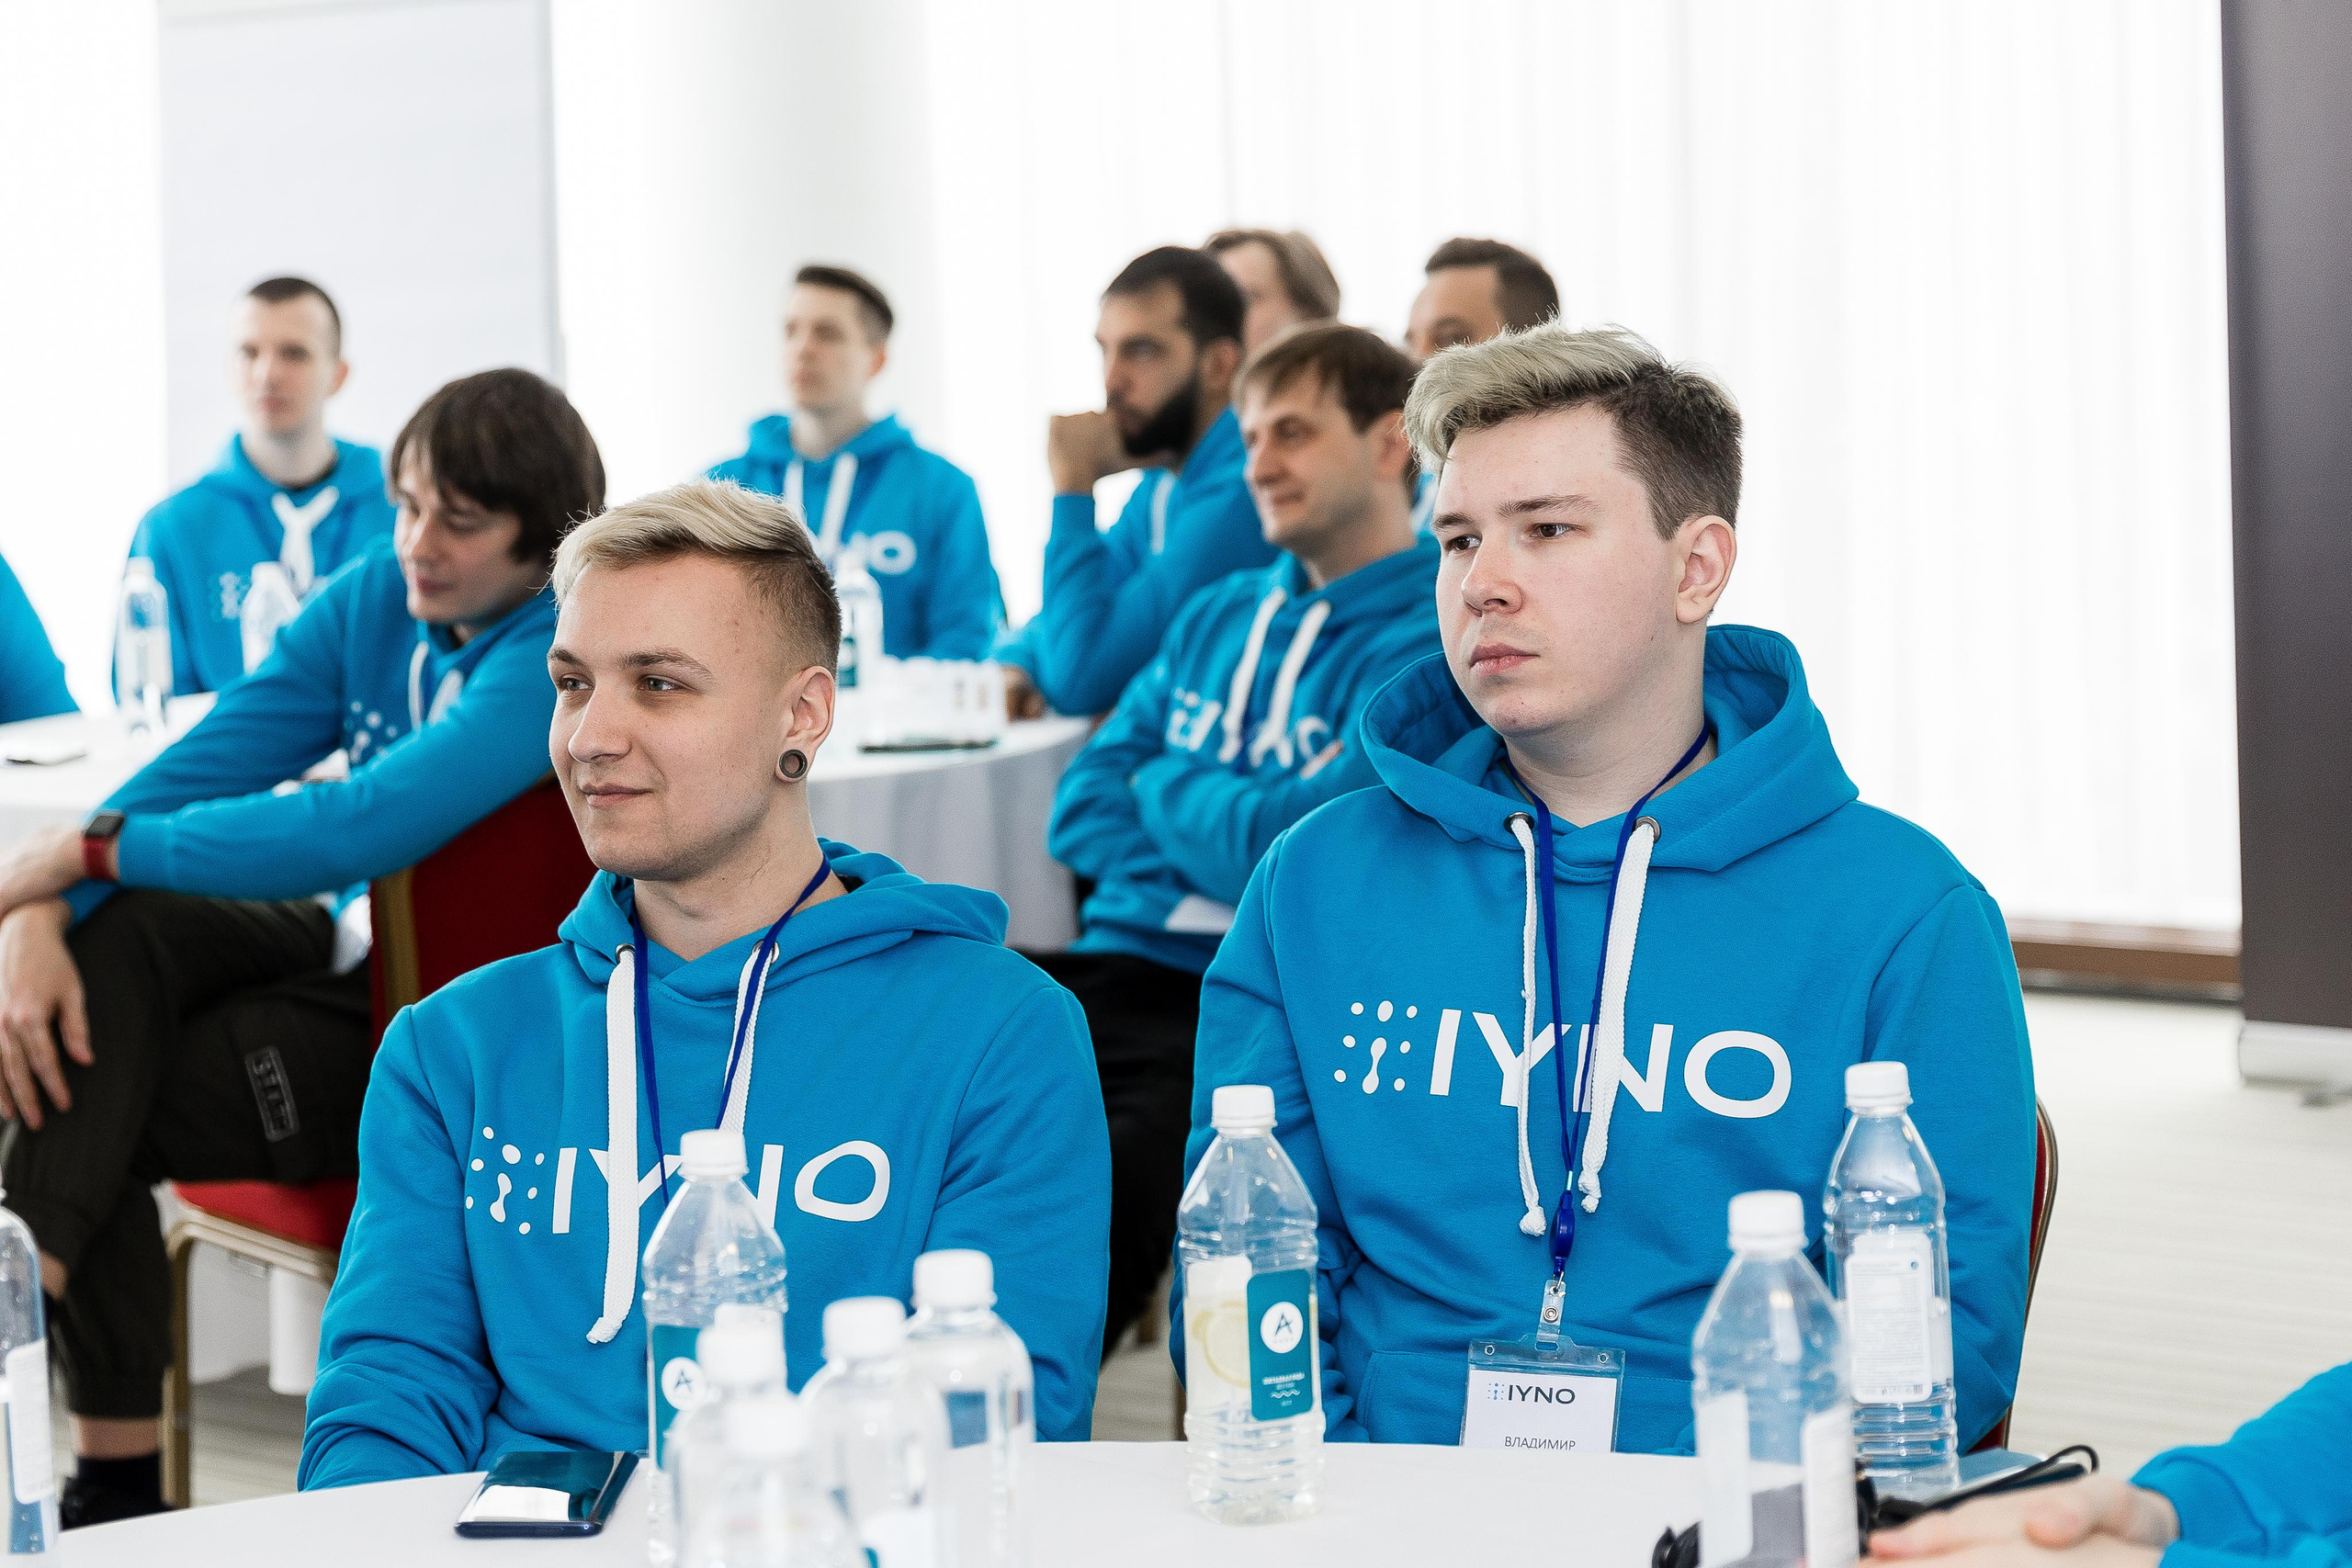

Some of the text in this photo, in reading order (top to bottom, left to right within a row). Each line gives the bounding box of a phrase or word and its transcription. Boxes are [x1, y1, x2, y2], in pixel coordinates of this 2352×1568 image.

[1430, 1009, 1792, 1118] IYNO
[1508, 1384, 1576, 1404] IYNO
[1504, 1436, 1577, 1451] ВЛАДИМИР
